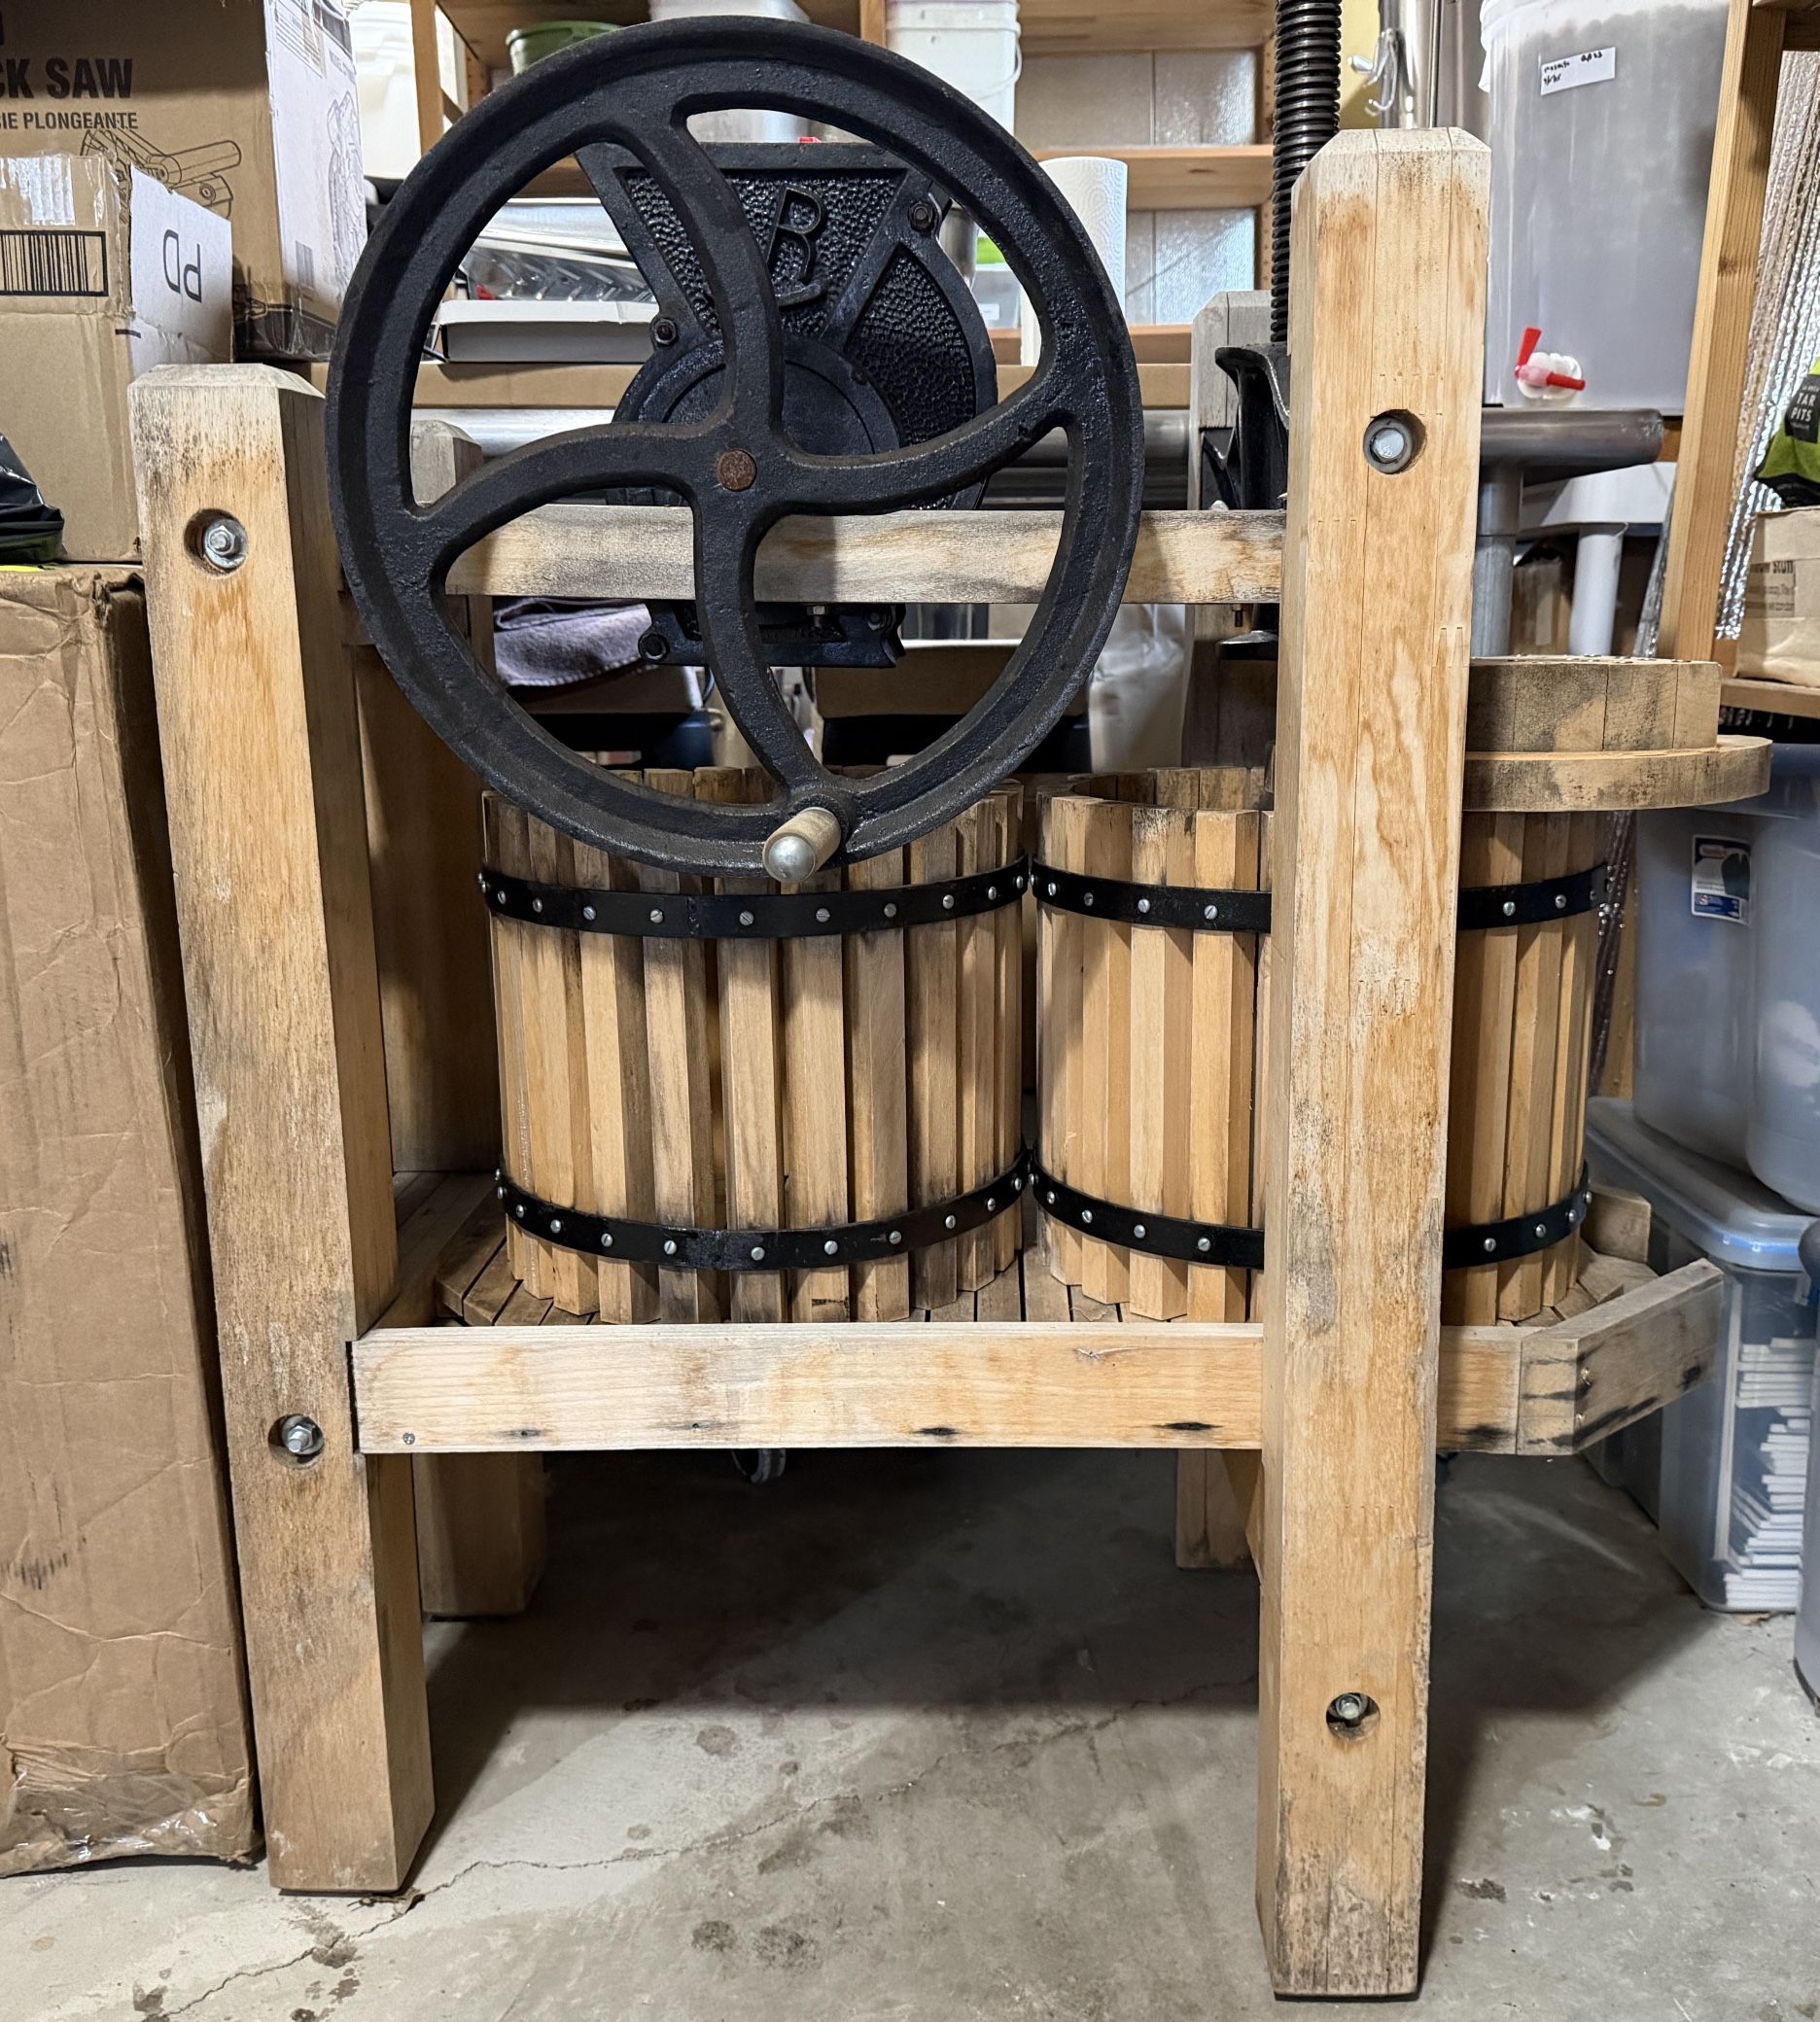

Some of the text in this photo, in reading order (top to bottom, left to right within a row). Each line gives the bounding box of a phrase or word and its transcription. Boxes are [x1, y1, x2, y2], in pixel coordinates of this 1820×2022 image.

[0, 56, 132, 98] K SAW
[0, 112, 138, 129] IE PLONGEANTE
[1797, 392, 1816, 406] TAR
[1791, 406, 1812, 422] PITS
